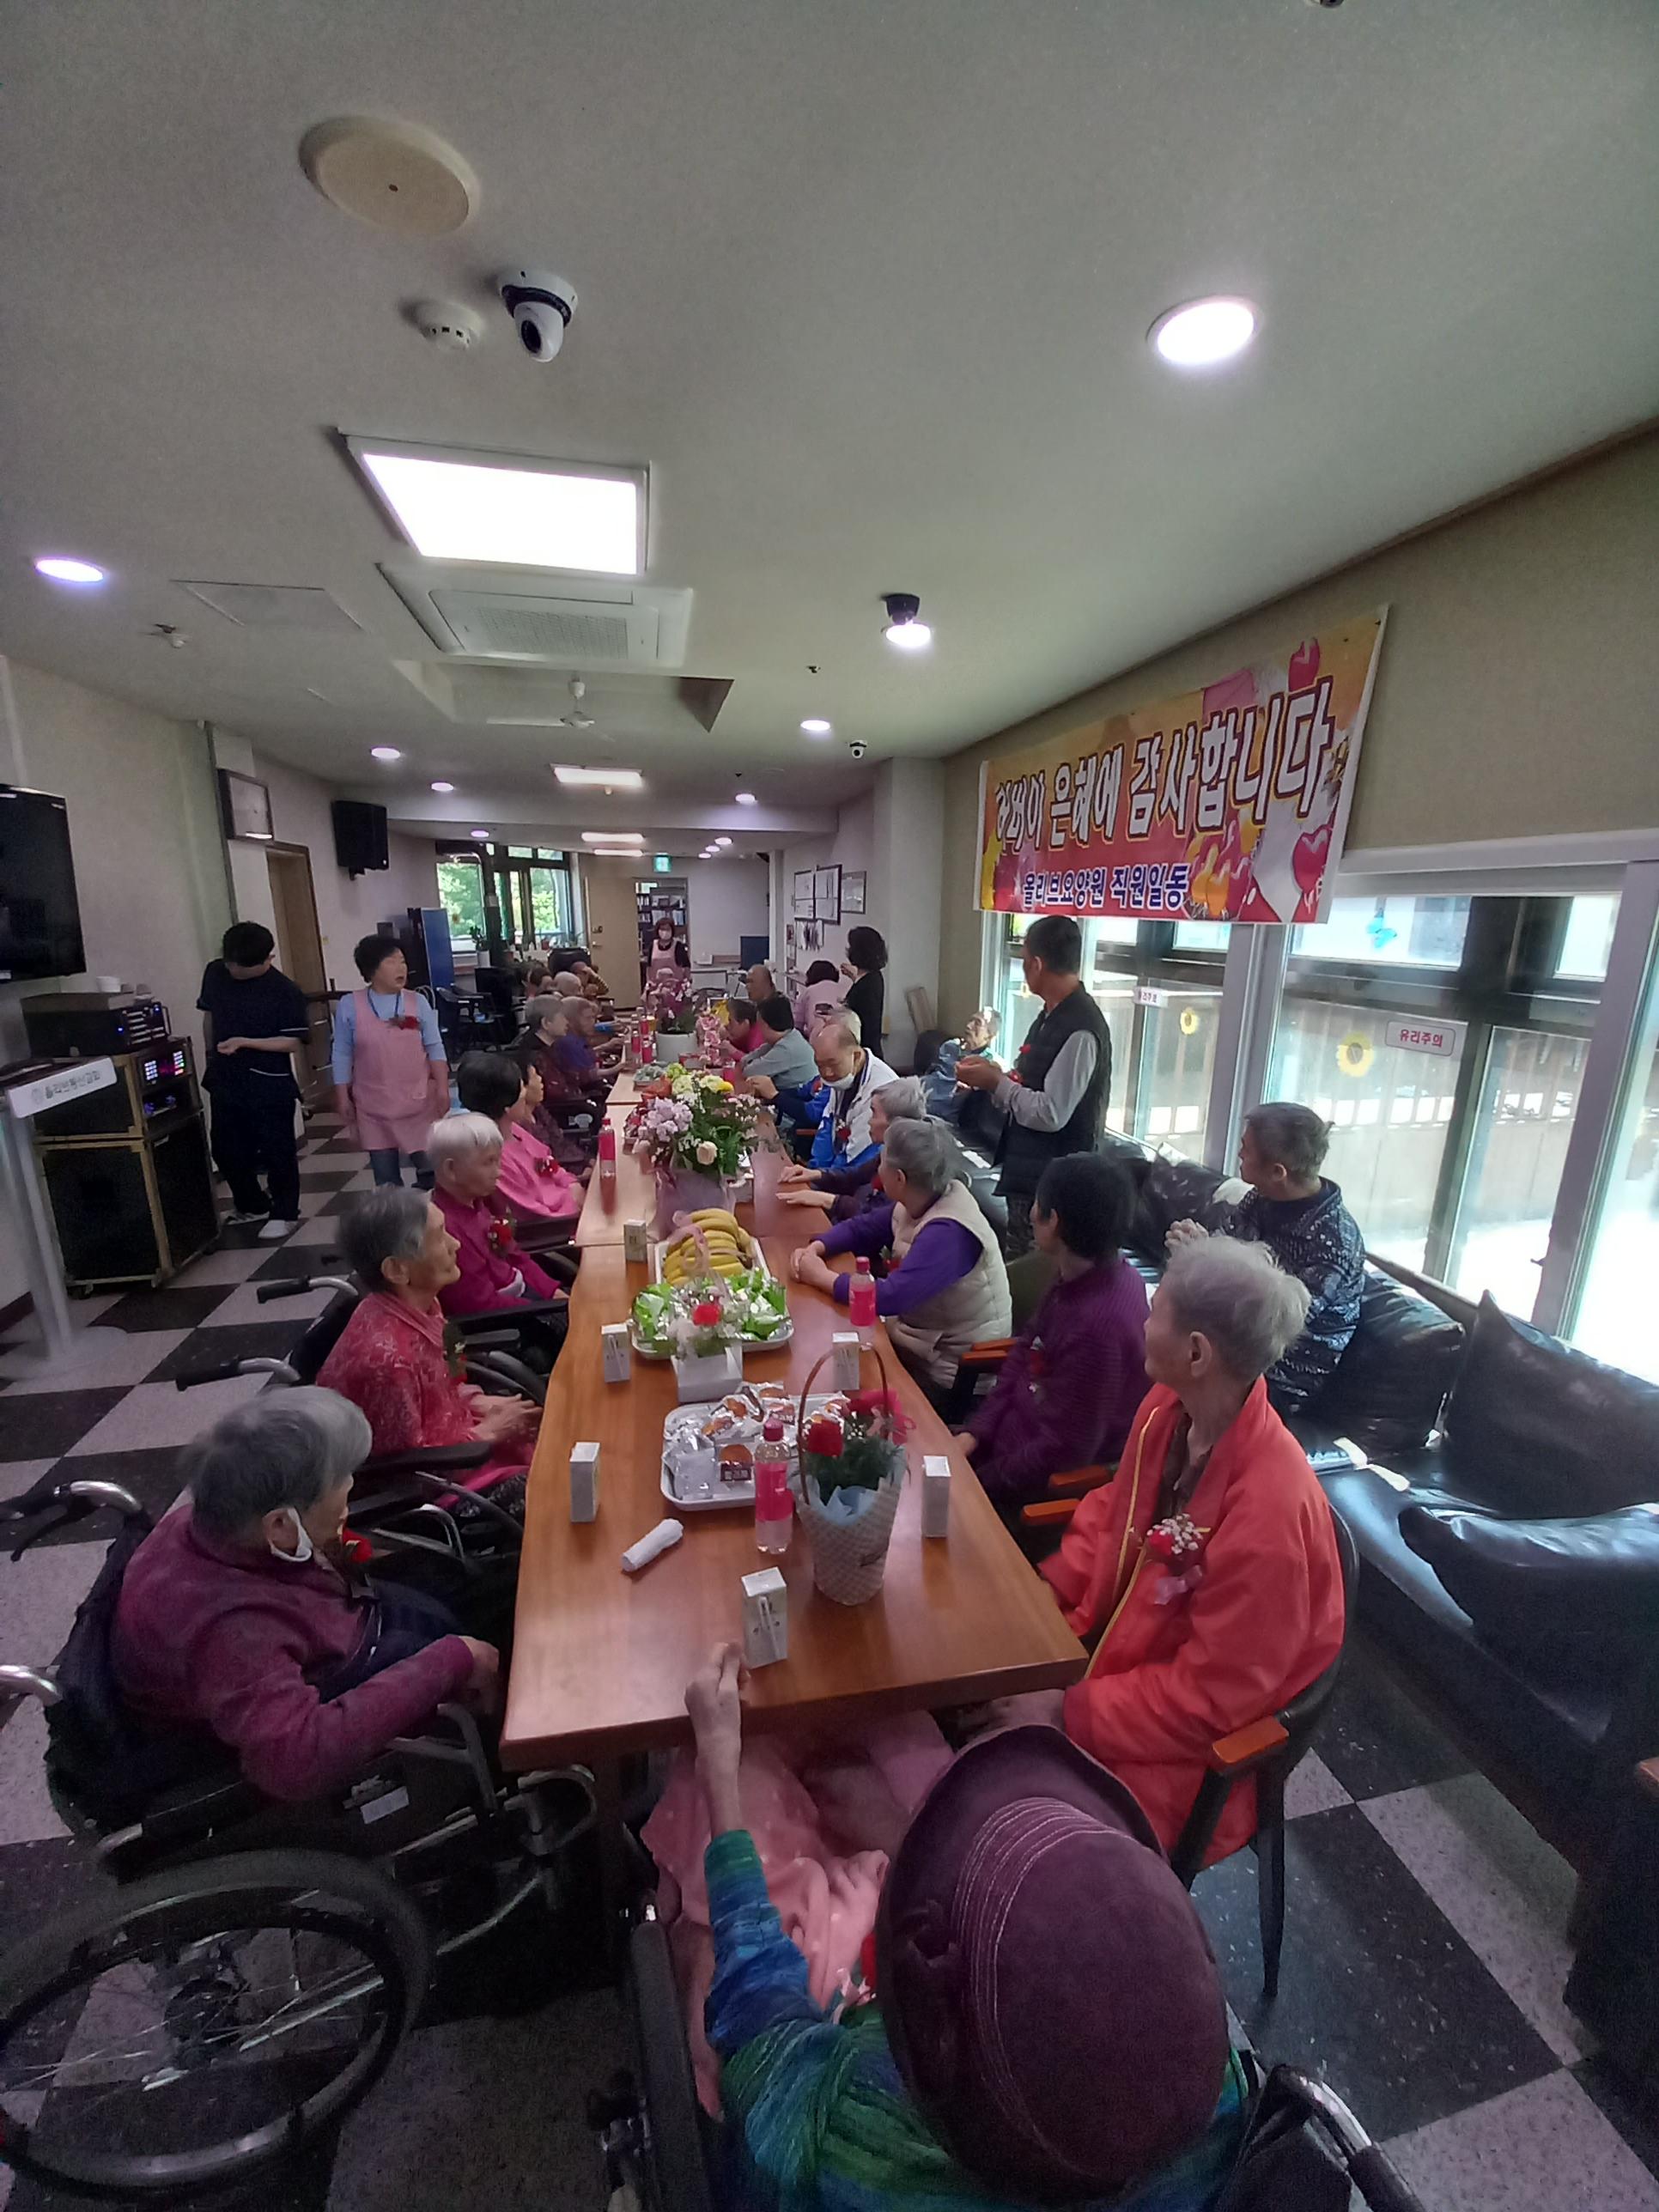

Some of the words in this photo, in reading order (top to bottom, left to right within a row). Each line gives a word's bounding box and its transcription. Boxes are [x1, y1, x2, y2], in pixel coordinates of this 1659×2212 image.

[1049, 743, 1124, 849] 은혜에
[1127, 675, 1335, 839] 감사합니다
[1023, 866, 1107, 911] 올리브요양원
[1109, 863, 1190, 910] 직원일동
[1400, 1029, 1443, 1048] 유리주의
